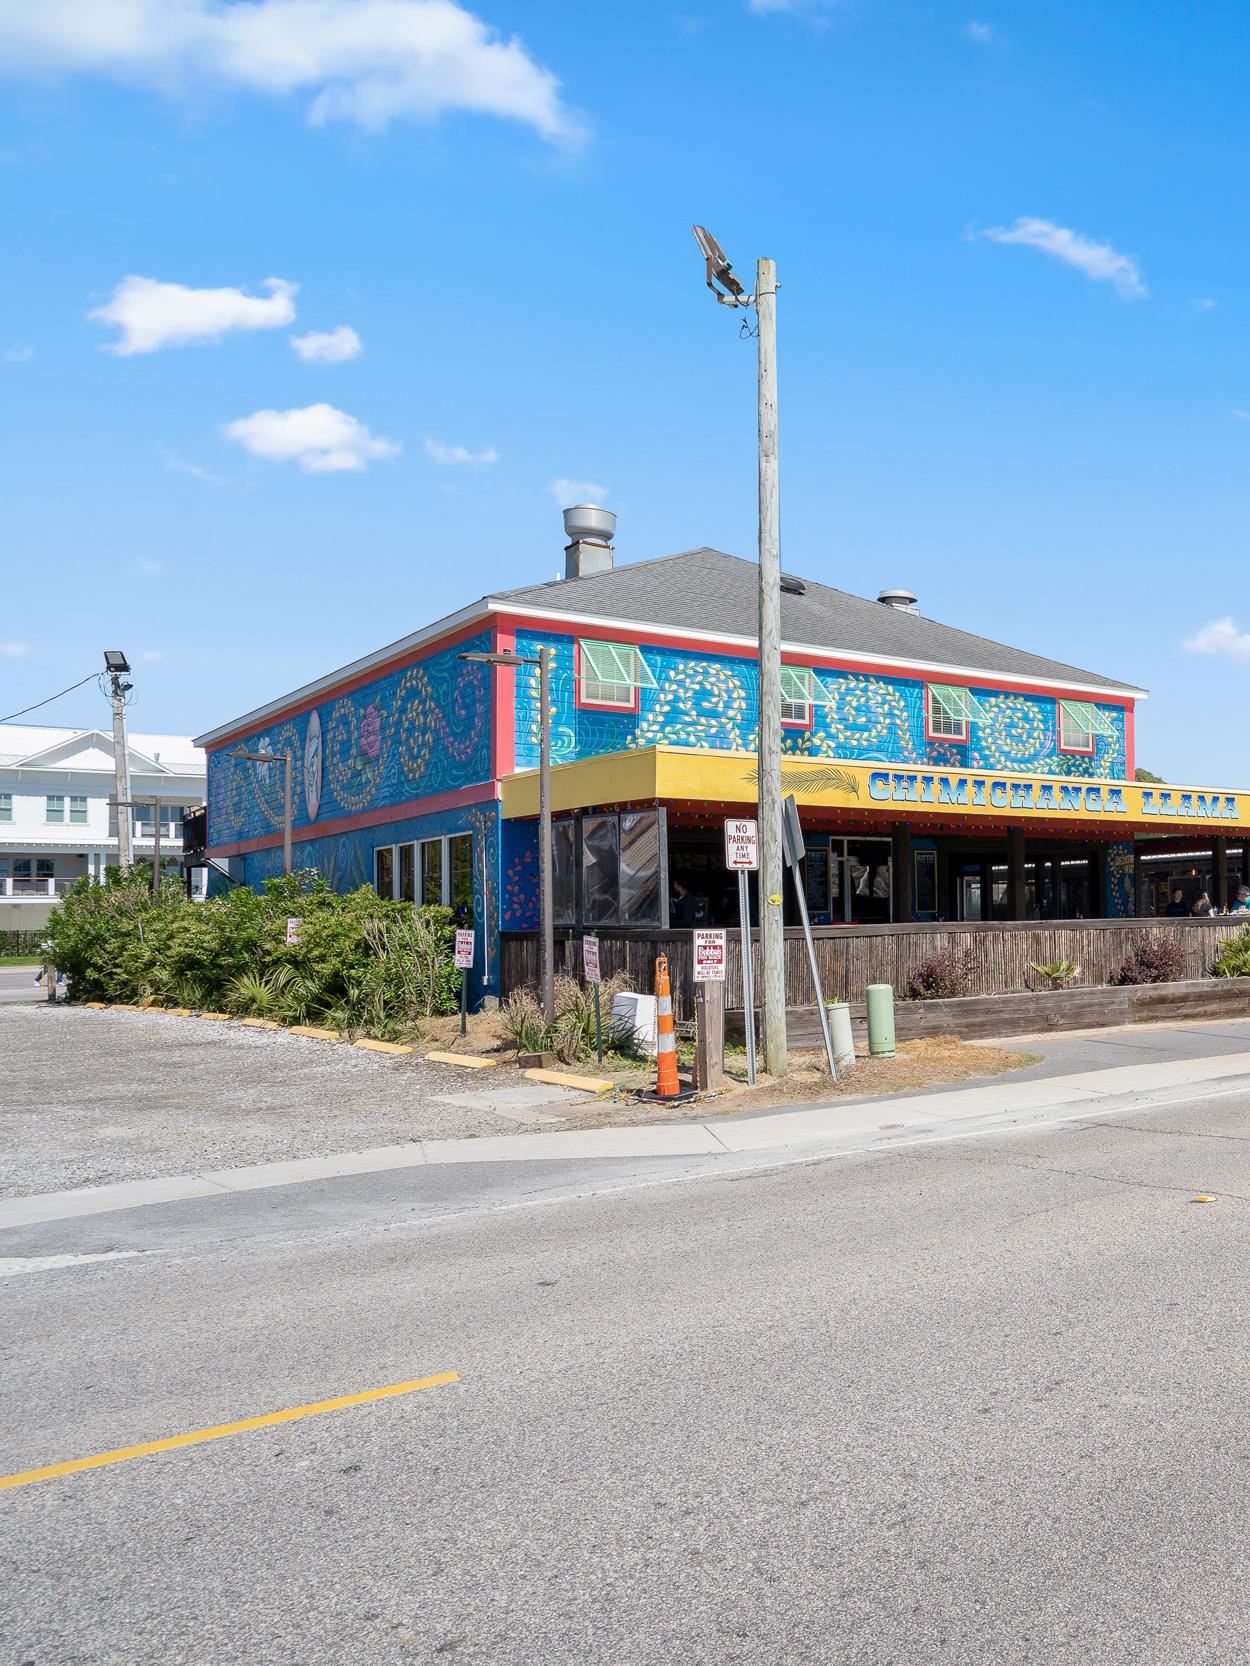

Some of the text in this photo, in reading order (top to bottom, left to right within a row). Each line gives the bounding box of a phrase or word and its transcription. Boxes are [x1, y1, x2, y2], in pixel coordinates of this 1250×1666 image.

[868, 771, 1128, 813] CHIMICHANGA
[1141, 791, 1239, 820] LLAMA
[735, 824, 748, 834] NO
[728, 835, 756, 845] PARKING
[697, 932, 723, 940] PARKING
